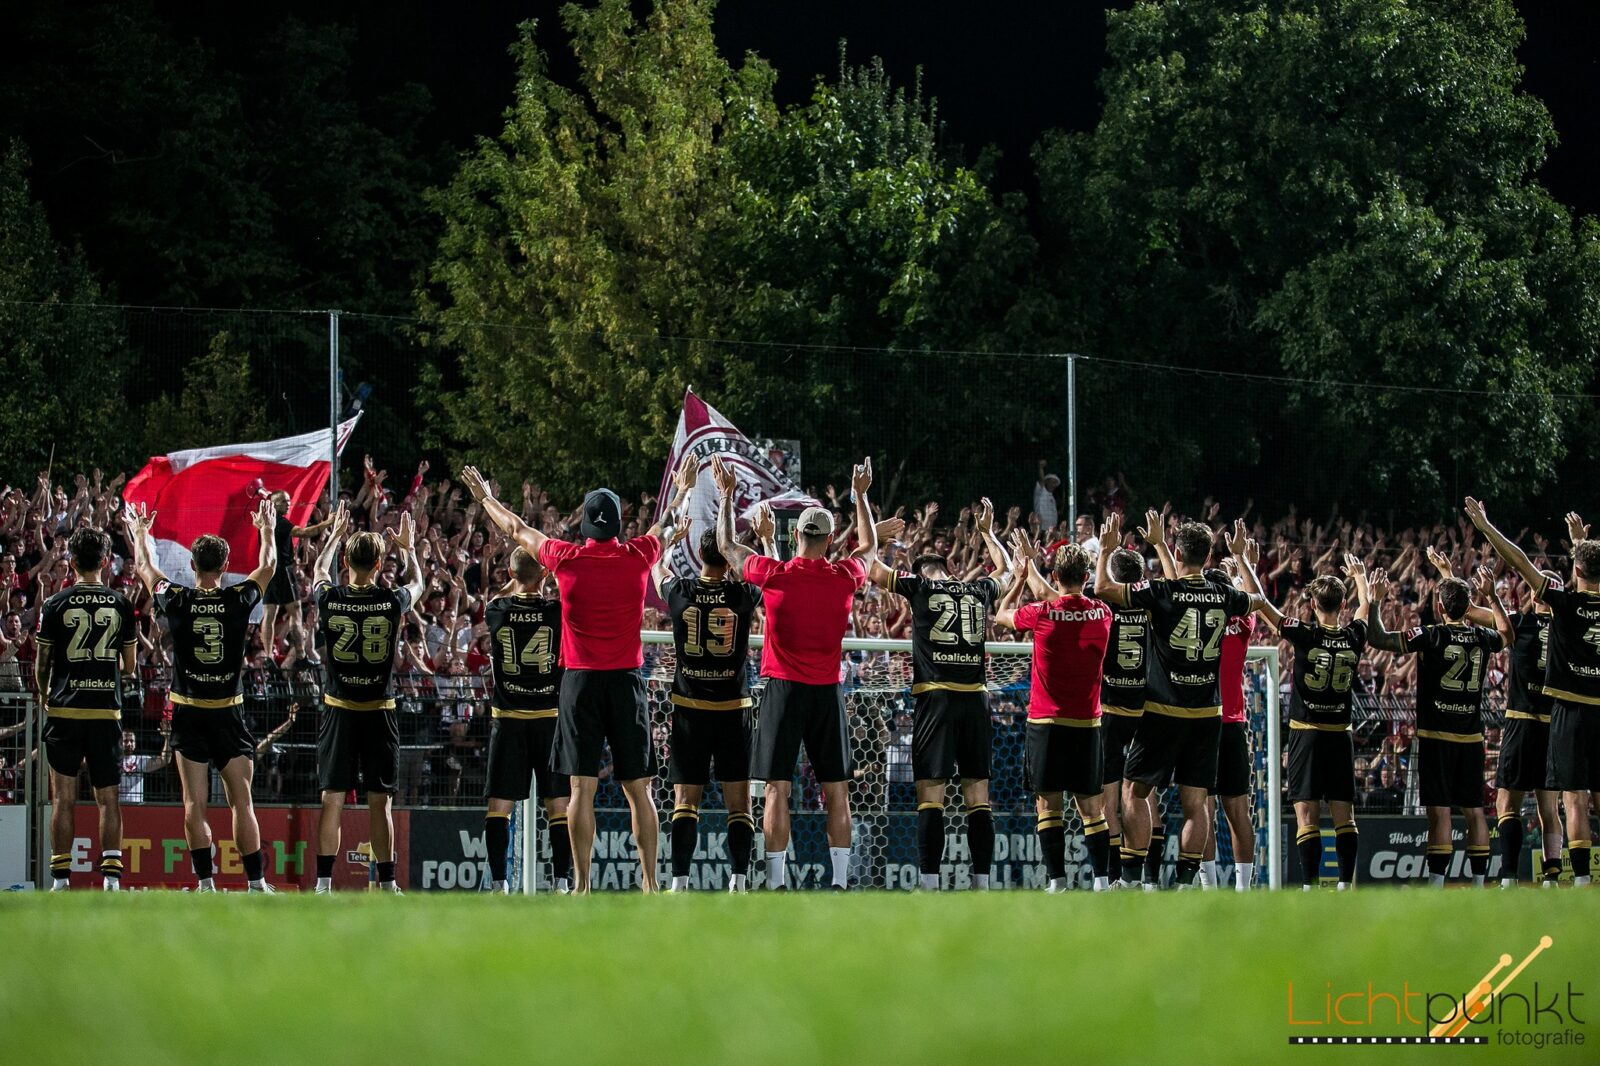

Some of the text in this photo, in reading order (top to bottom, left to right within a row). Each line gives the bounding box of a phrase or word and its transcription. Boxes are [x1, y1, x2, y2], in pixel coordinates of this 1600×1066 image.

[69, 595, 116, 605] COPADO
[327, 602, 392, 612] BRETSCHNEIDER
[509, 612, 543, 622] HASSE
[928, 593, 985, 646] 20
[1048, 607, 1105, 622] macron
[1172, 591, 1226, 604] PRONICHEV
[63, 608, 122, 662] 22
[193, 616, 224, 664] 3
[328, 615, 392, 664] 28
[496, 626, 555, 675] 14
[682, 606, 738, 656] 19
[1117, 625, 1144, 670] 5
[1169, 607, 1227, 661] 42
[69, 679, 116, 689] Kalick.de
[682, 666, 736, 678] Koalick.de
[1304, 647, 1358, 692] 36
[1440, 645, 1483, 692] 21
[1388, 832, 1414, 845] Hier
[886, 863, 1017, 889] FOTBLL
